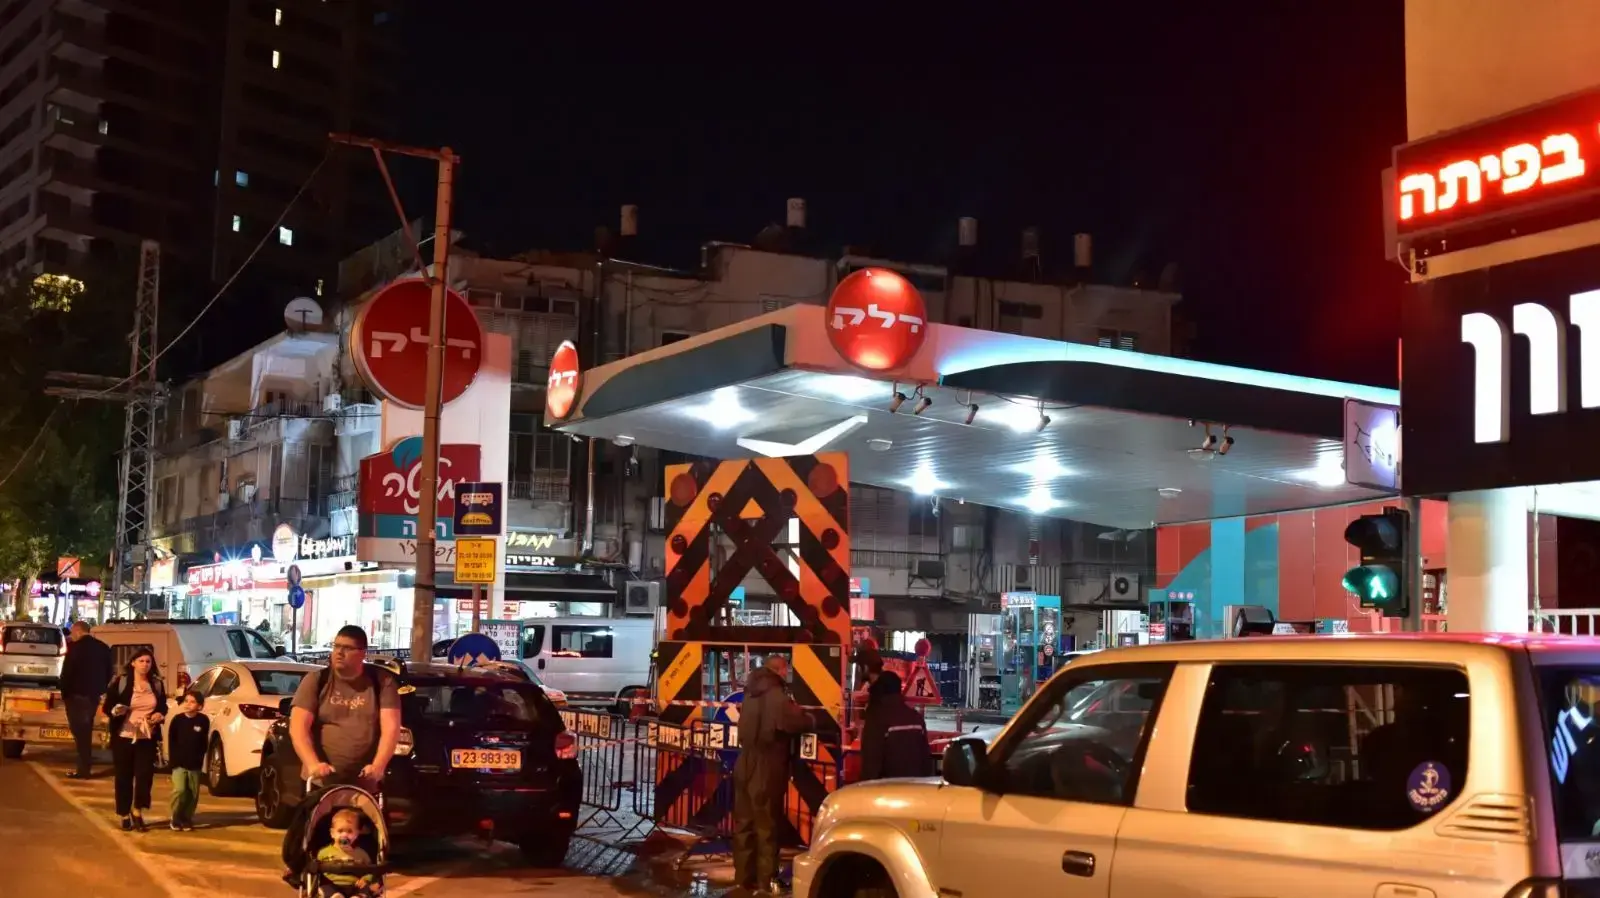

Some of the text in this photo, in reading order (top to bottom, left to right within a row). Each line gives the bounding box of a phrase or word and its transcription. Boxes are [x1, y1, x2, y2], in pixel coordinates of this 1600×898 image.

[1399, 131, 1585, 221] בפיתה
[832, 303, 924, 334] דלק
[330, 695, 366, 710] Google
